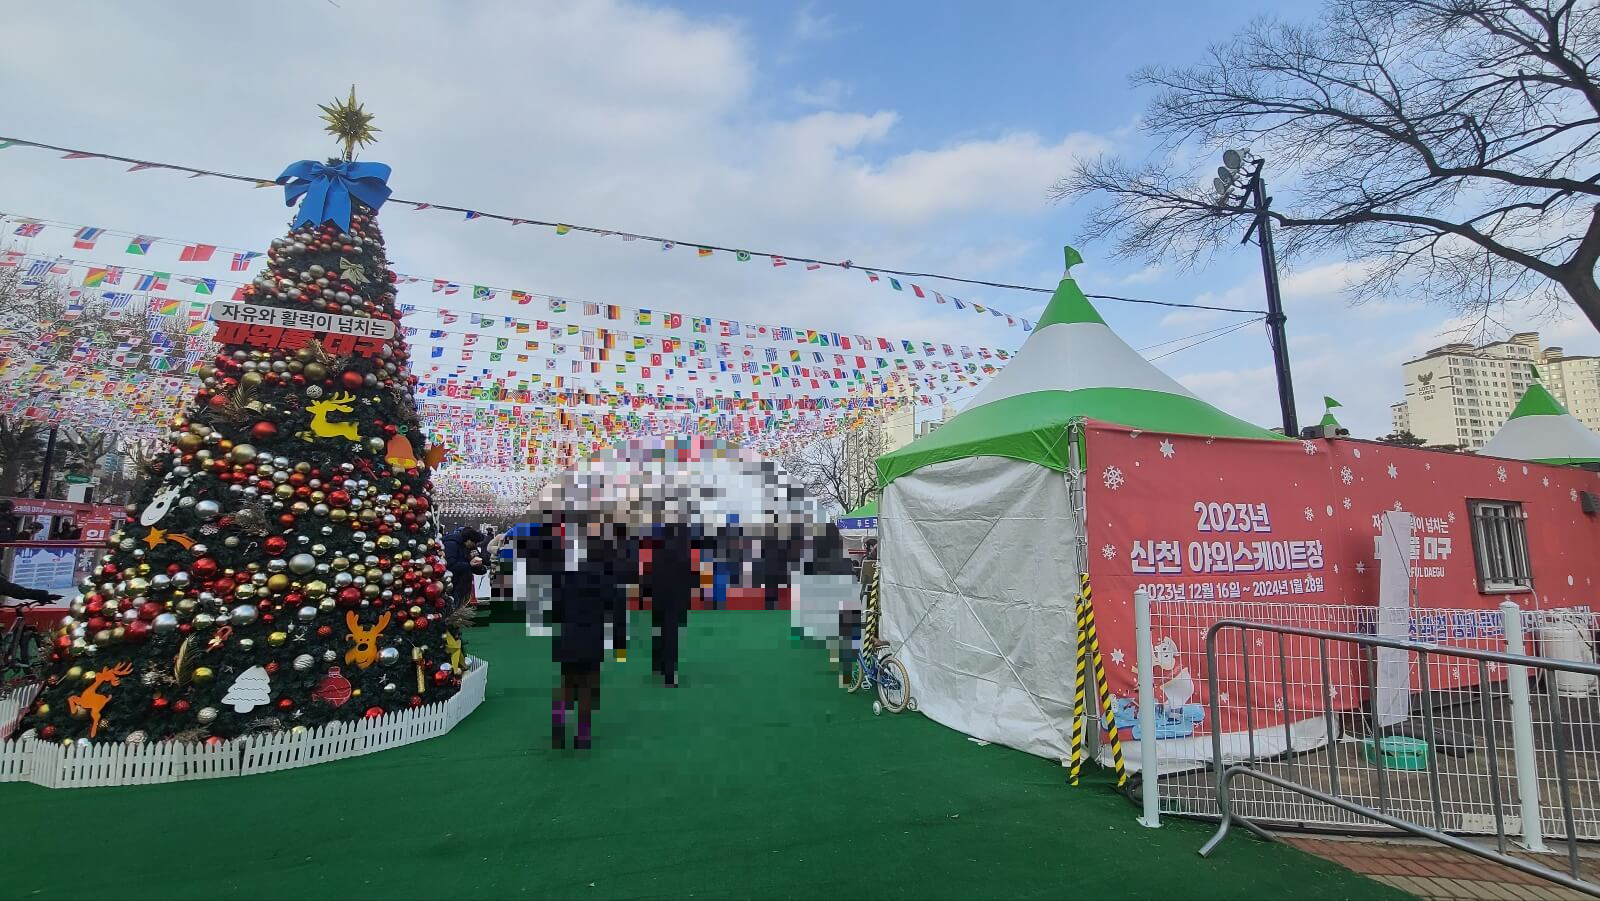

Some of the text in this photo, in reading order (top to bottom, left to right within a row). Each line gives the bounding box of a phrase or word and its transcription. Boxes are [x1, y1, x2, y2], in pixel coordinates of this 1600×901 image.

[222, 304, 387, 337] 자유와 활력이 넘치는
[213, 320, 386, 358] 파워풀 대구
[1193, 502, 1271, 533] 2023년
[1425, 517, 1449, 534] 넘치는
[1130, 539, 1324, 574] 신천 야외스케이트장
[1425, 567, 1445, 578] DAEGU
[1188, 582, 1215, 600] 12월
[1216, 581, 1241, 599] 16일
[1252, 580, 1289, 597] 2024년
[1289, 578, 1303, 595] 1월
[1304, 577, 1324, 593] 28일
